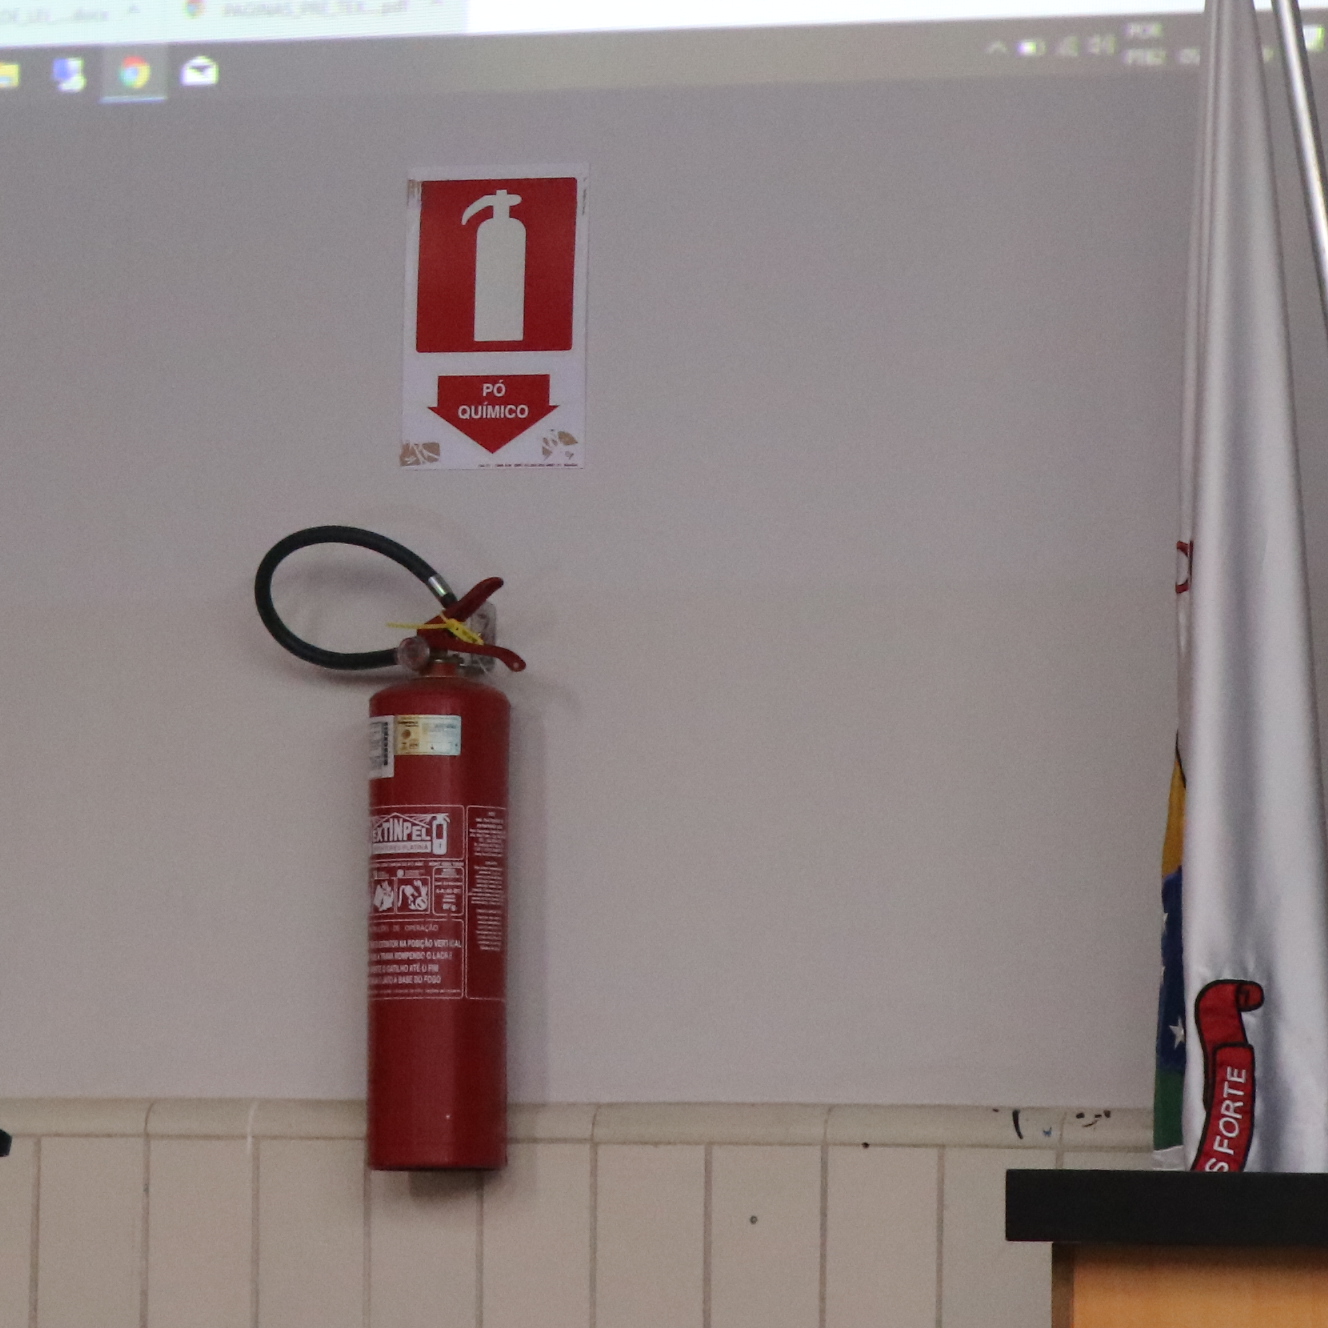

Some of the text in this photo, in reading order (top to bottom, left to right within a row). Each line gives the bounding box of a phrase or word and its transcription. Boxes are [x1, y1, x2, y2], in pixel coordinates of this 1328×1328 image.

[483, 380, 505, 398] PÓ
[458, 401, 529, 421] QUÍMICO
[372, 817, 431, 842] EXTINPEL
[1213, 1066, 1247, 1156] FORTE
